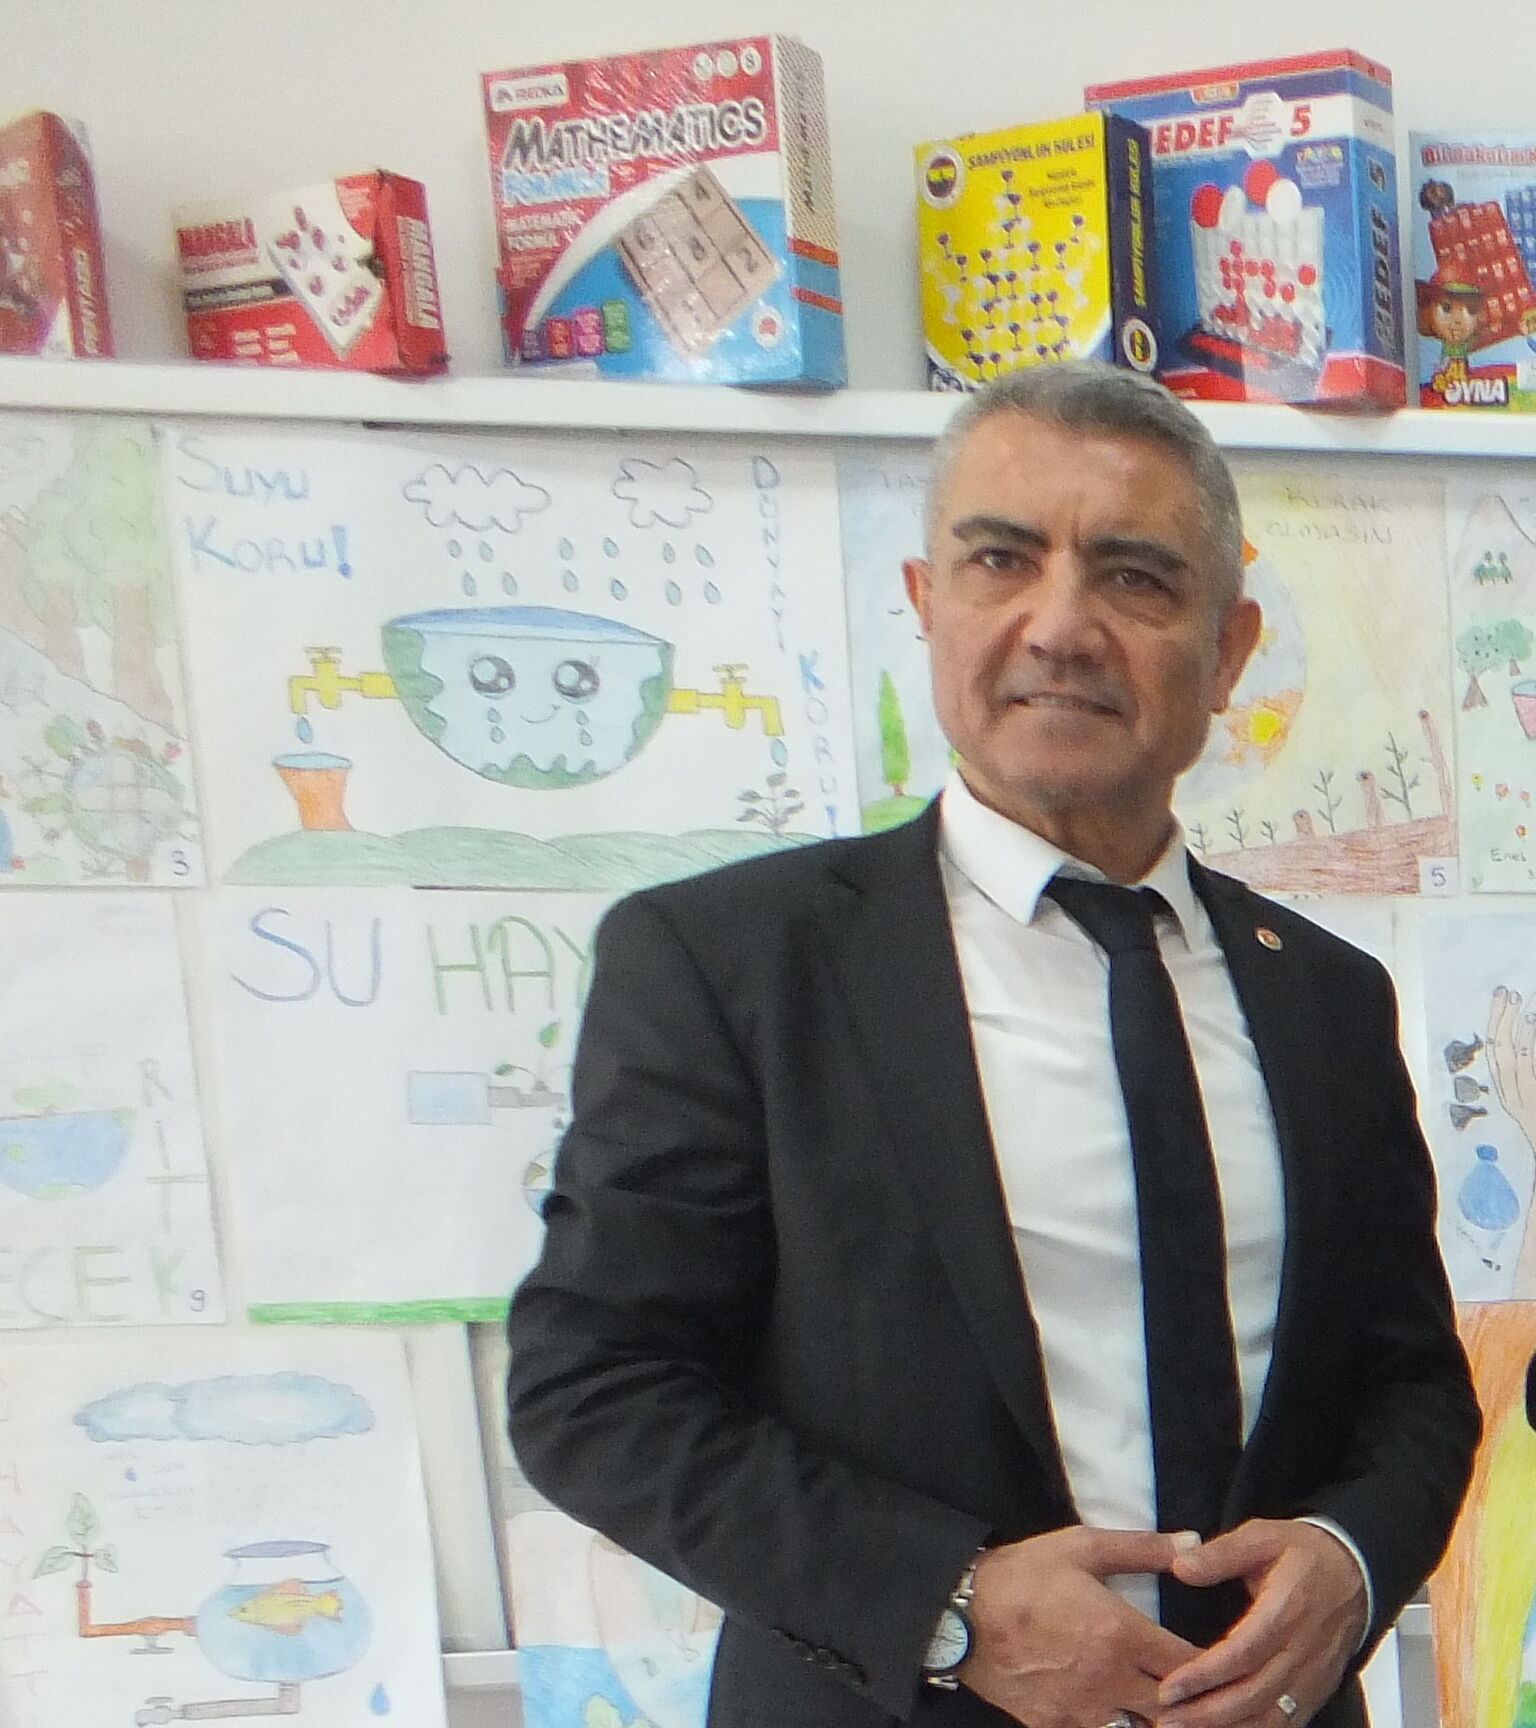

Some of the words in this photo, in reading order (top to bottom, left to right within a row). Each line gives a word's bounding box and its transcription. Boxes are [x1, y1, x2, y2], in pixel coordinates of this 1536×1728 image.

[502, 98, 768, 172] MATHEMATICS
[1152, 116, 1235, 155] EDEF
[1291, 105, 1312, 136] 5
[1431, 866, 1447, 888] 5
[231, 906, 382, 1007] SU
[426, 916, 598, 1015] HAY
